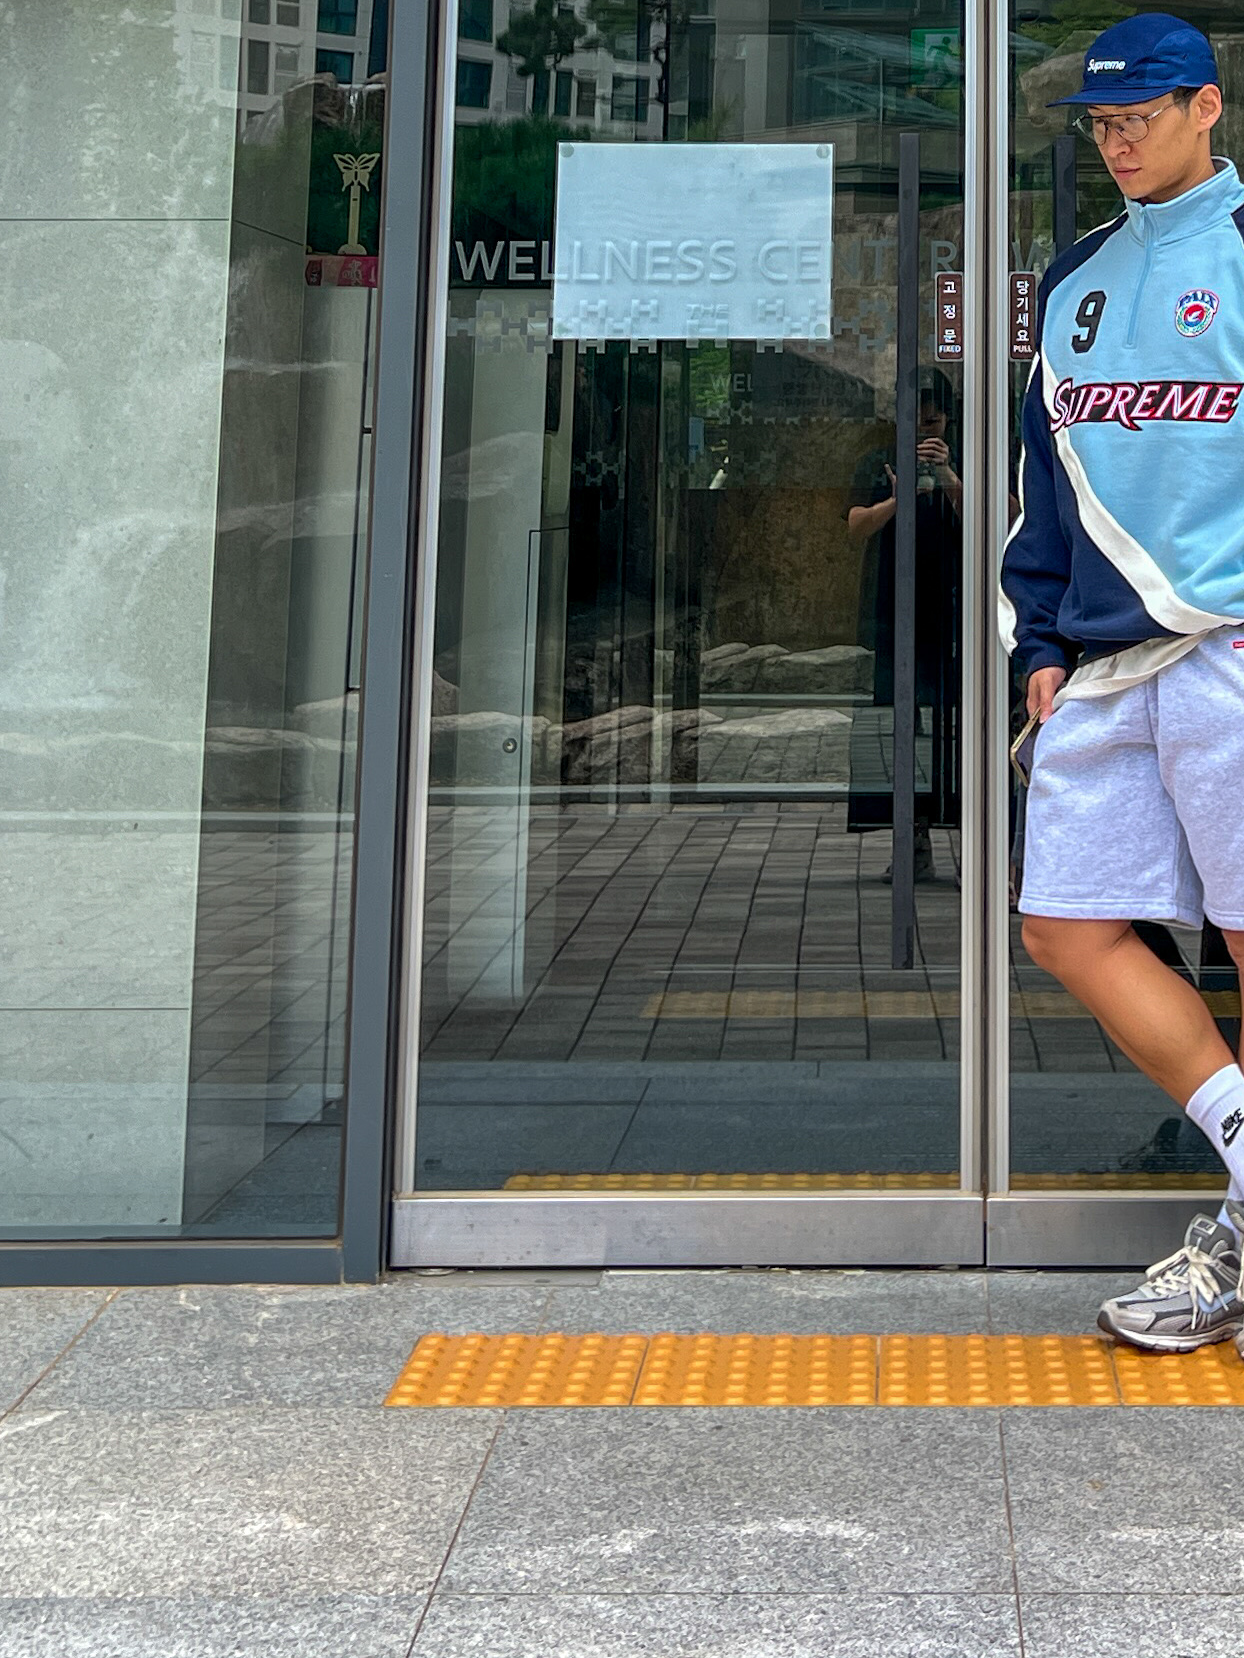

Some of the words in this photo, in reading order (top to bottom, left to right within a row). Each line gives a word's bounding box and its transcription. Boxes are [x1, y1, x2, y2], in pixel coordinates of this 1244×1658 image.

[1087, 58, 1126, 75] Supreme
[455, 240, 737, 281] WELLNESS
[757, 239, 958, 281] CENTR
[943, 281, 957, 343] 고정문
[1016, 280, 1030, 342] 당기세요
[1071, 291, 1106, 354] 9
[938, 344, 962, 354] FIXED
[1013, 344, 1033, 354] PULL
[1049, 377, 1244, 432] SUPREME
